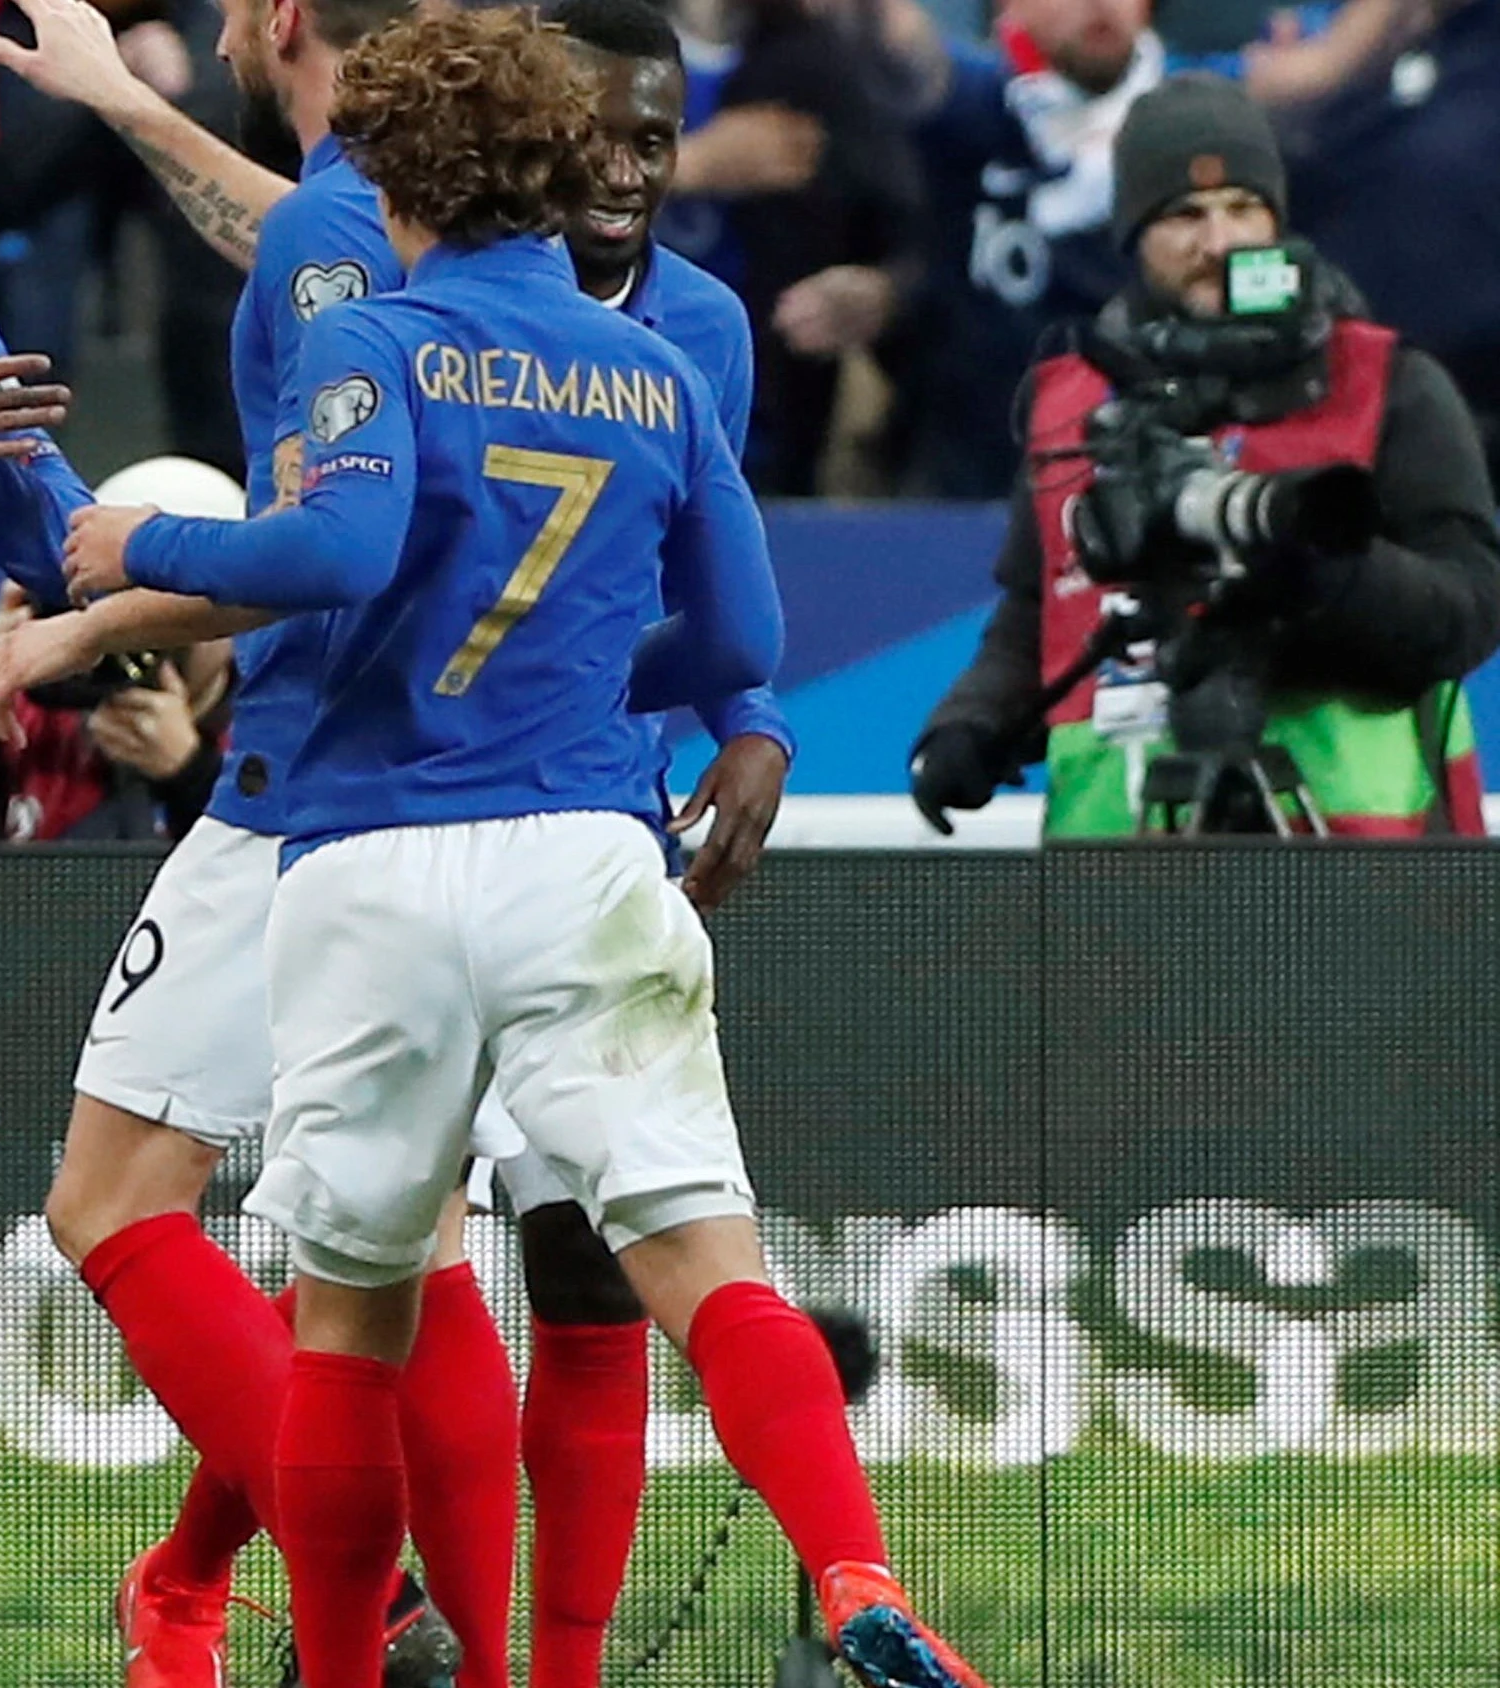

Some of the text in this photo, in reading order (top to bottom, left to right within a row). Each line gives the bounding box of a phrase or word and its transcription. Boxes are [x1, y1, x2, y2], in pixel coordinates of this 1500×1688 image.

[415, 341, 678, 434] GRIEZMANN
[432, 443, 617, 697] 7
[109, 919, 164, 1014] 9
